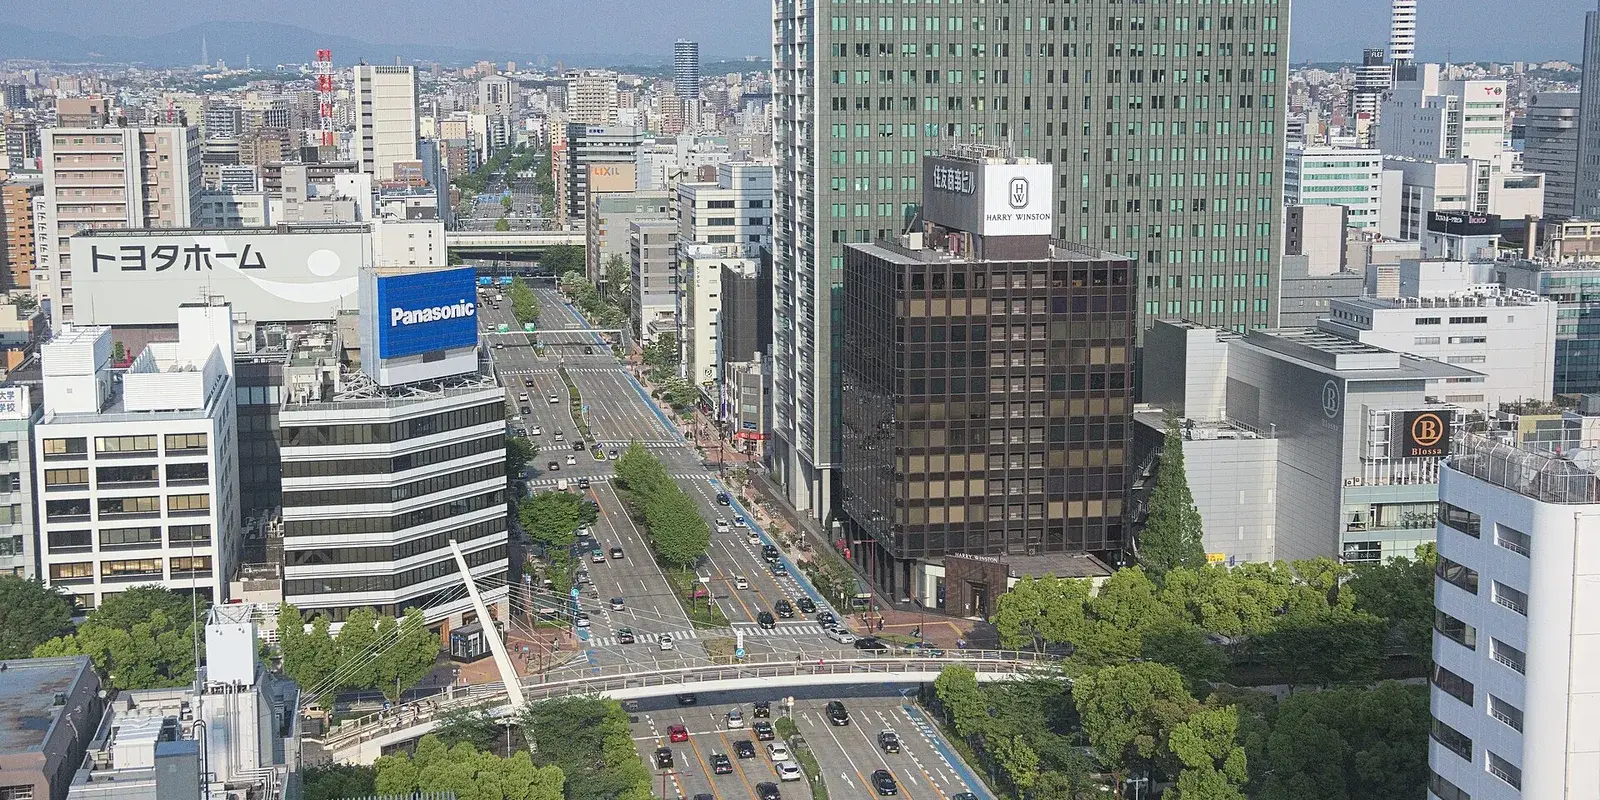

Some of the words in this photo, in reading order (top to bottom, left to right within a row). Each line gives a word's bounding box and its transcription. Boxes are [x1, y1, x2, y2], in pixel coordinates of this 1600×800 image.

[594, 167, 620, 176] LIXIL
[933, 164, 975, 194] 住友商事ビル
[91, 244, 267, 273] トヨタホーム
[391, 299, 475, 327] Panasonic
[0, 391, 15, 400] 大学
[1411, 448, 1442, 456] Blossa
